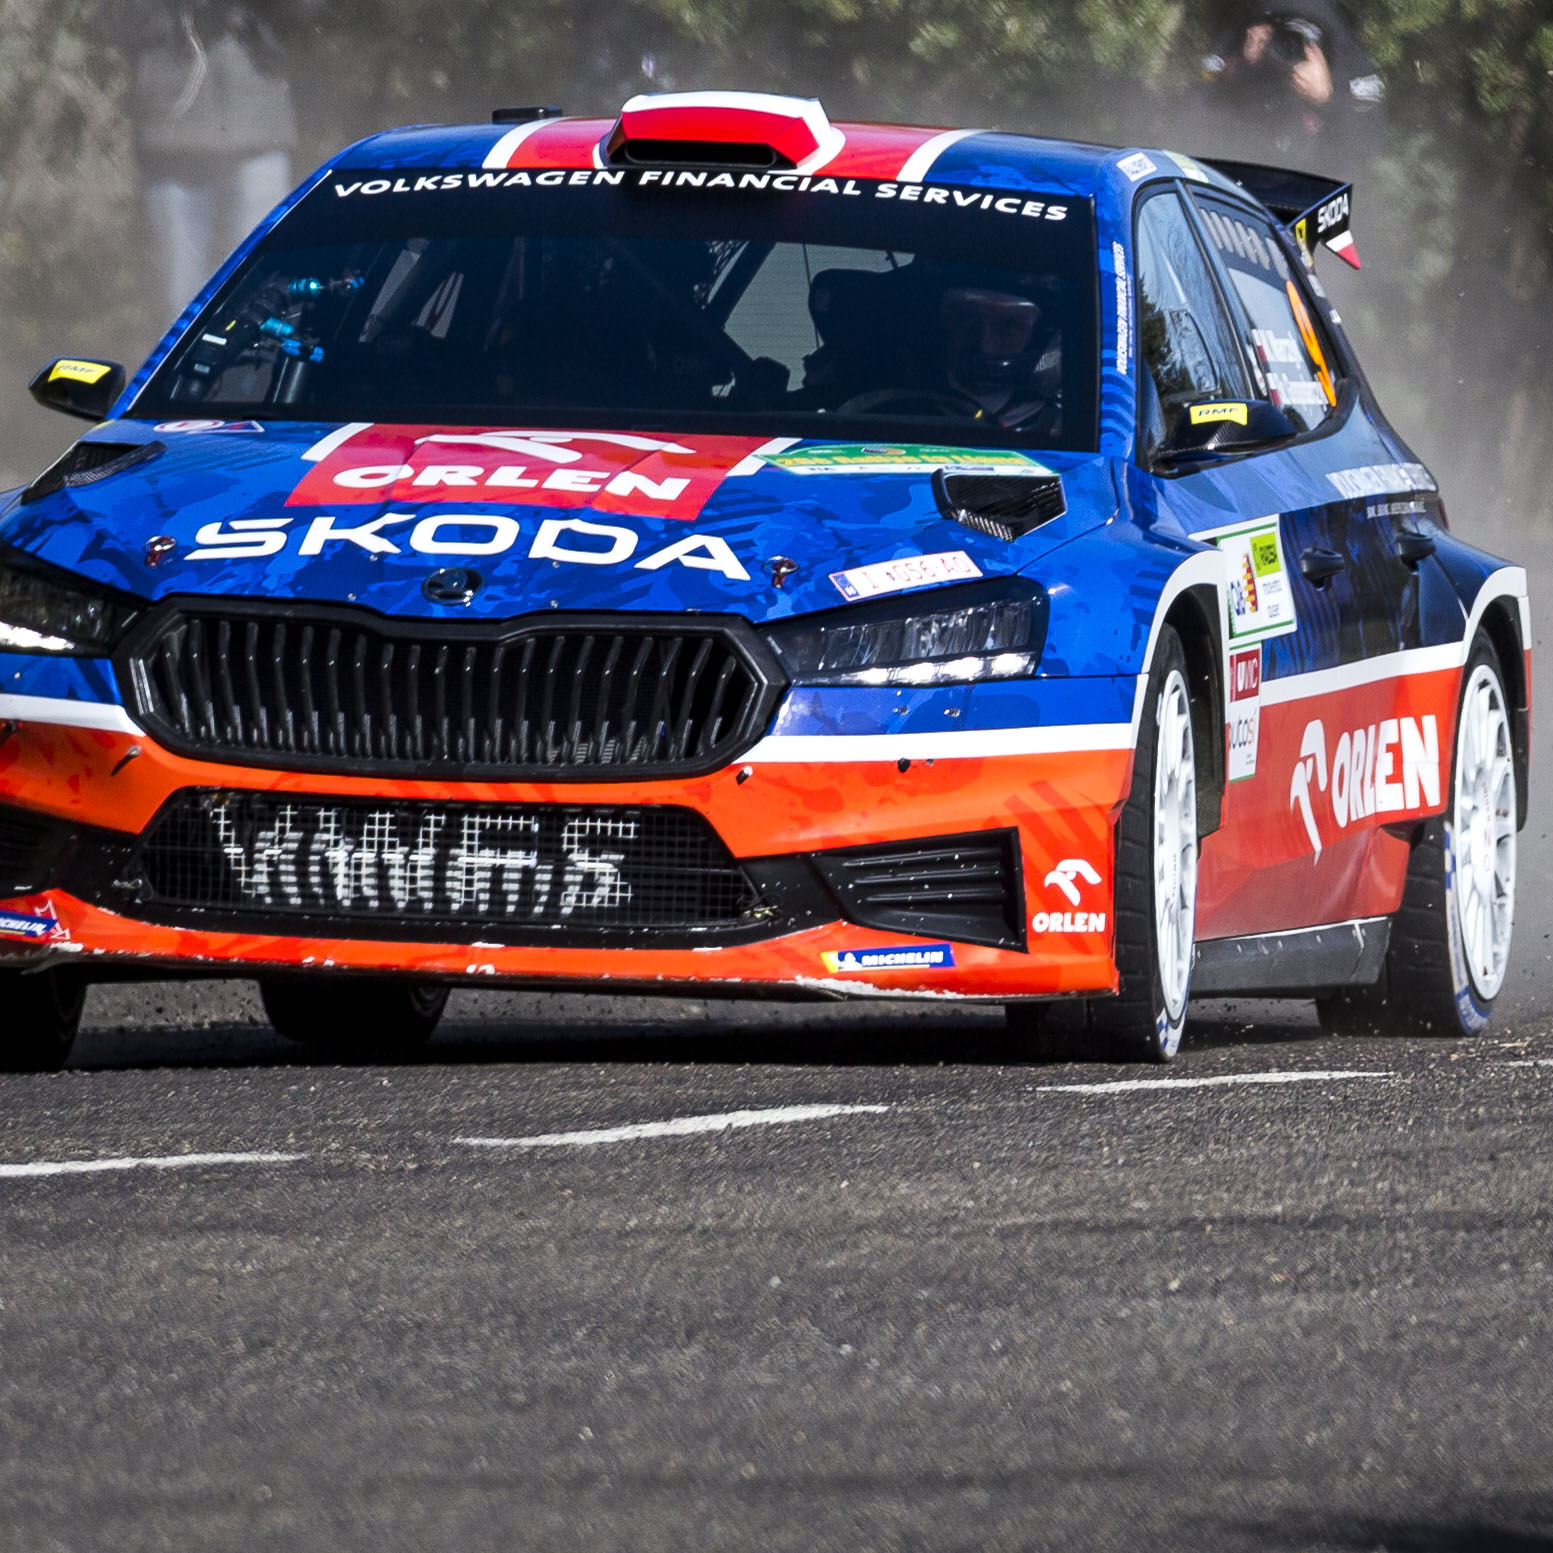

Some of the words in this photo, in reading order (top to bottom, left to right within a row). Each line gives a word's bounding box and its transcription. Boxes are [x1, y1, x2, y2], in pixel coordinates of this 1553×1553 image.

[334, 170, 623, 198] VOLKSWAGEN
[638, 169, 862, 197] FINANCIAL
[874, 182, 1068, 222] SERVICES
[332, 464, 691, 501] ORLEN
[1331, 713, 1441, 829] ORLEN
[1032, 911, 1106, 933] ORLEN
[861, 951, 944, 966] MICHELIN
